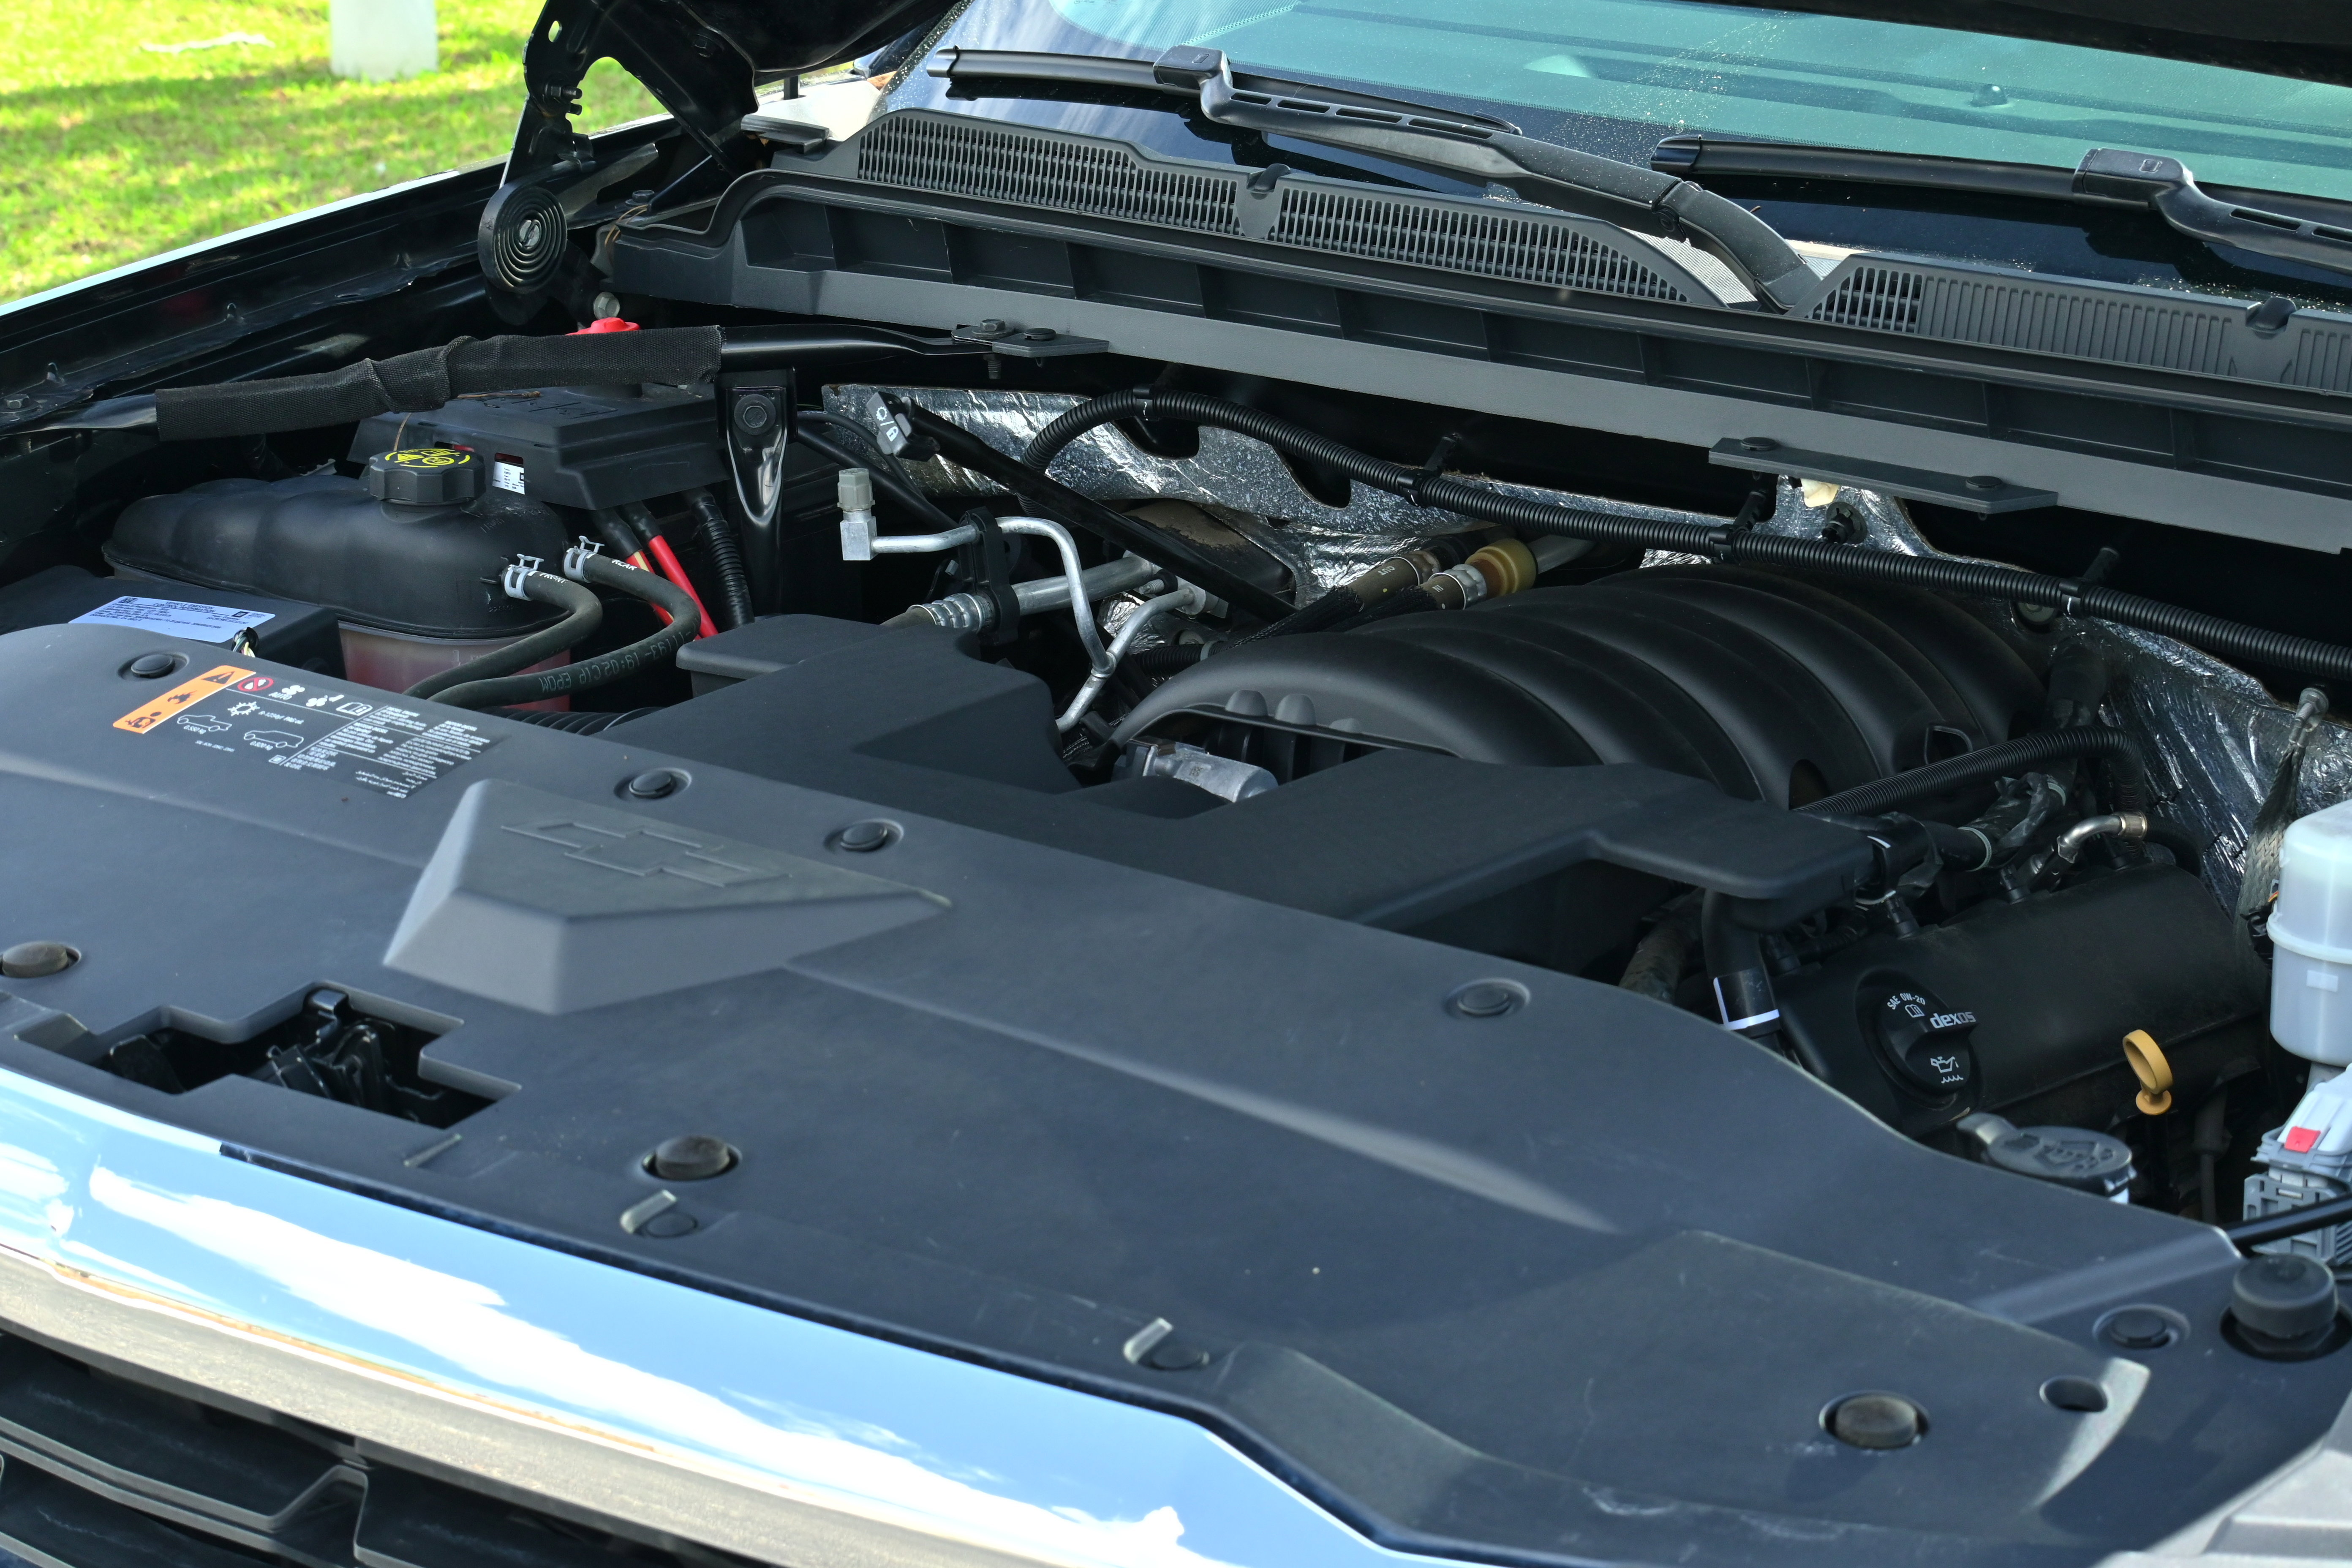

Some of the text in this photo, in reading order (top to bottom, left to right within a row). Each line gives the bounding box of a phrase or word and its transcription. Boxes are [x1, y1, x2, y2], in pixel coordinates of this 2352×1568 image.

[1378, 566, 1395, 575] OUT
[1432, 584, 1444, 592] IN
[268, 691, 292, 700] AUTO
[1887, 993, 1926, 1010] SAE 0W-20
[1930, 1012, 1976, 1029] dexos
